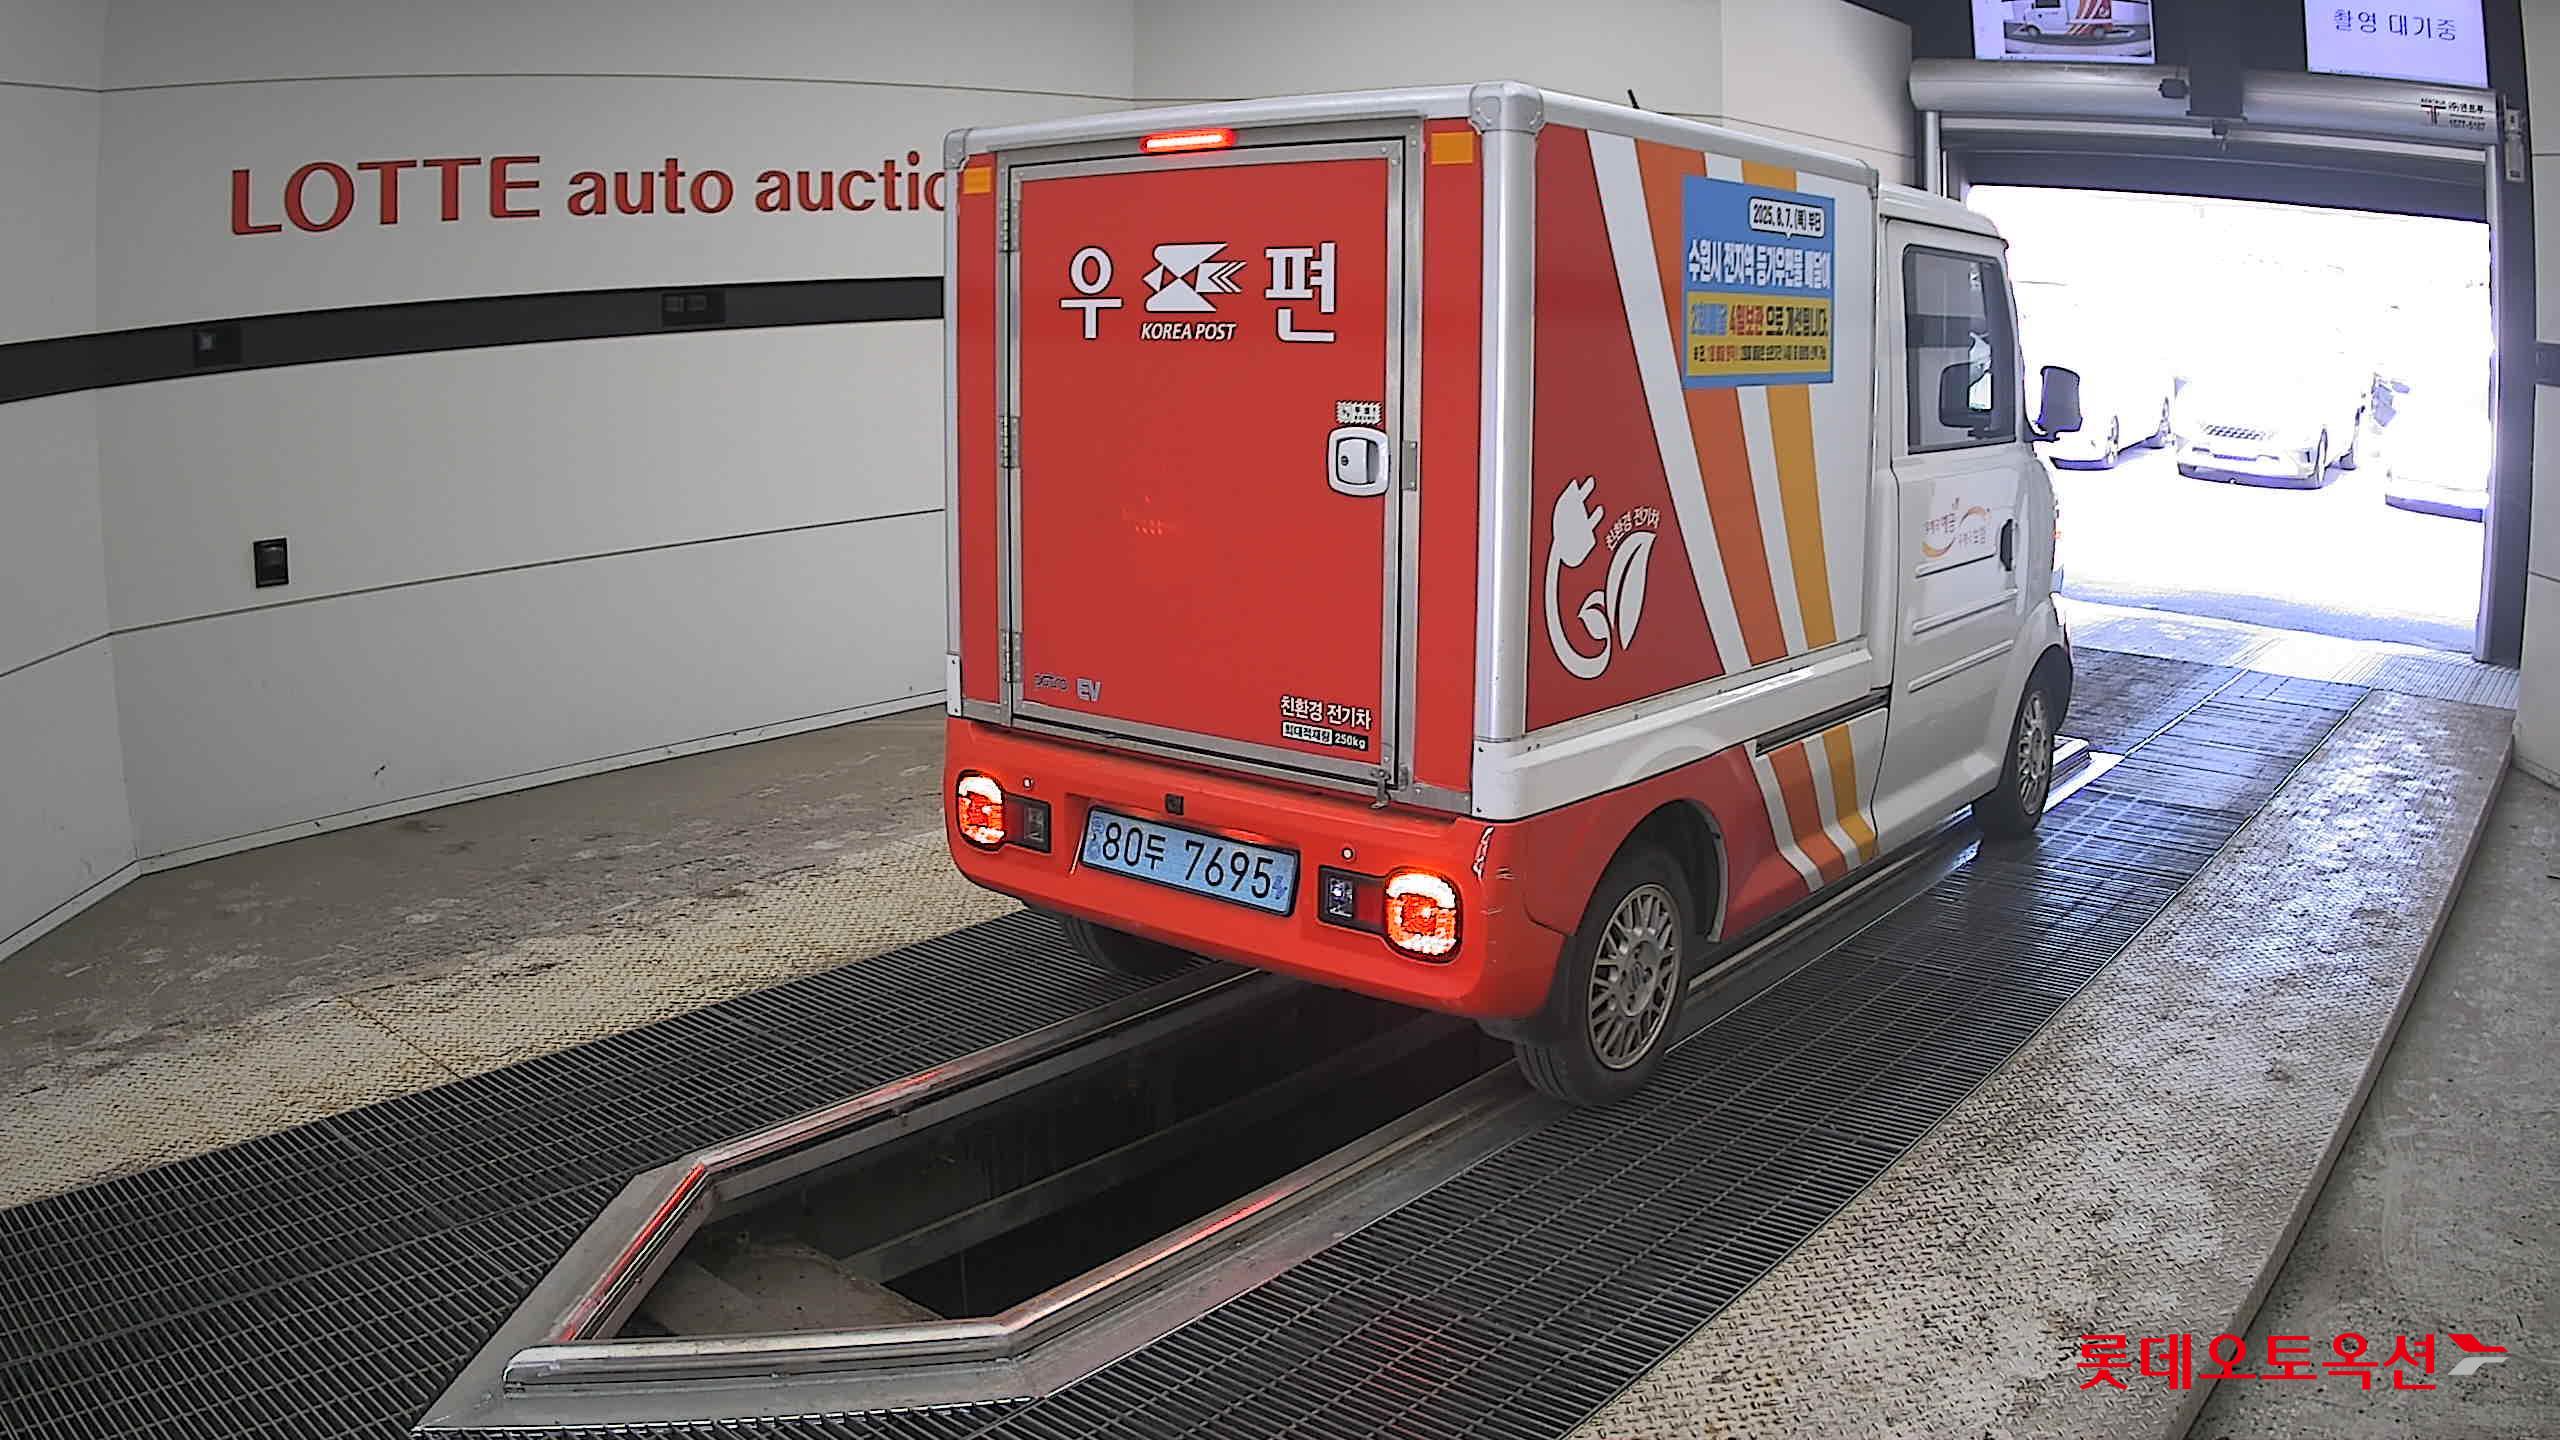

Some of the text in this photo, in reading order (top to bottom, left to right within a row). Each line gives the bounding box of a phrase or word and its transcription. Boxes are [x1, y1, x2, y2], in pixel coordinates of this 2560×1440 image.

[2334, 9, 2456, 41] 촬영 대기중
[231, 155, 541, 236] LOTTE
[567, 158, 734, 216] auto
[1688, 239, 1722, 282] 수원시
[1141, 323, 1237, 341] KOREA POST
[1077, 678, 1101, 702] EV
[1280, 695, 1372, 730] 친환경 전기차
[1334, 732, 1367, 750] 250kg
[1102, 822, 1274, 899] 80두 7695
